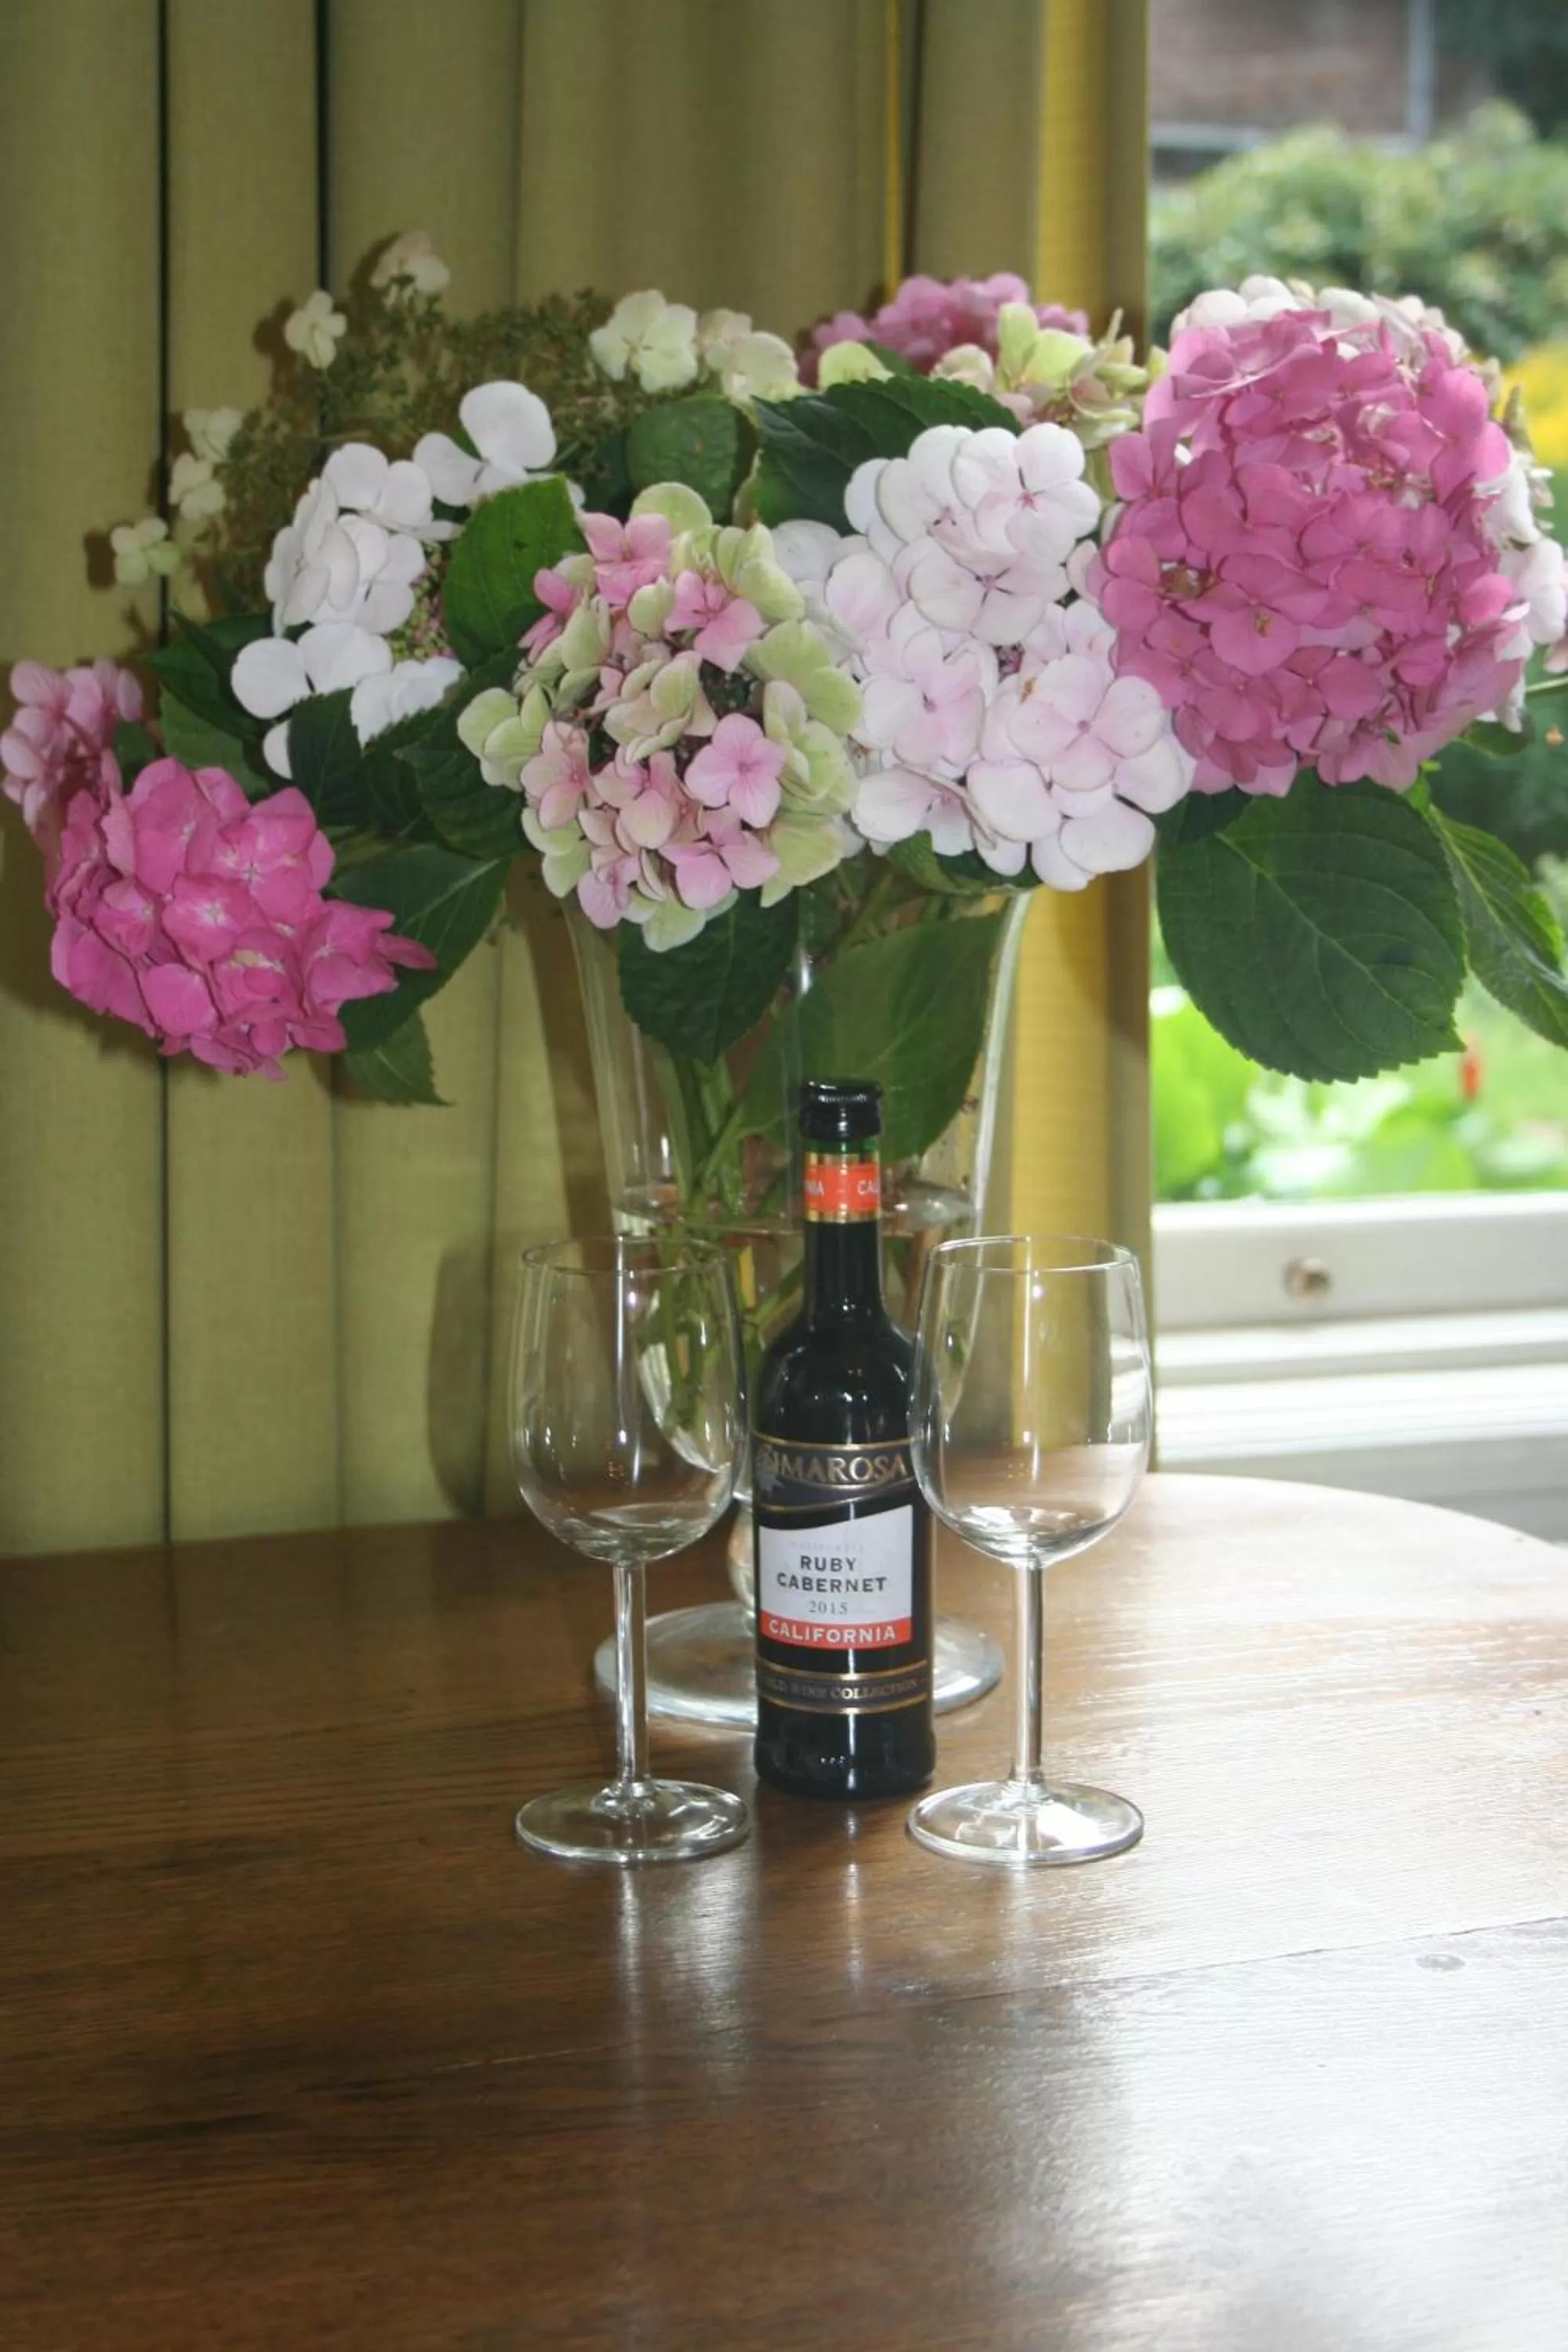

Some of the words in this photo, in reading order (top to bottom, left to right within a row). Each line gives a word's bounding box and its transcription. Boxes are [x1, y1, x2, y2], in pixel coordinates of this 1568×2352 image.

[800, 1555, 857, 1573] RUBY
[777, 1572, 887, 1593] CABERNET
[808, 1599, 848, 1615] 2015
[769, 1618, 897, 1643] CALIFORNIA
